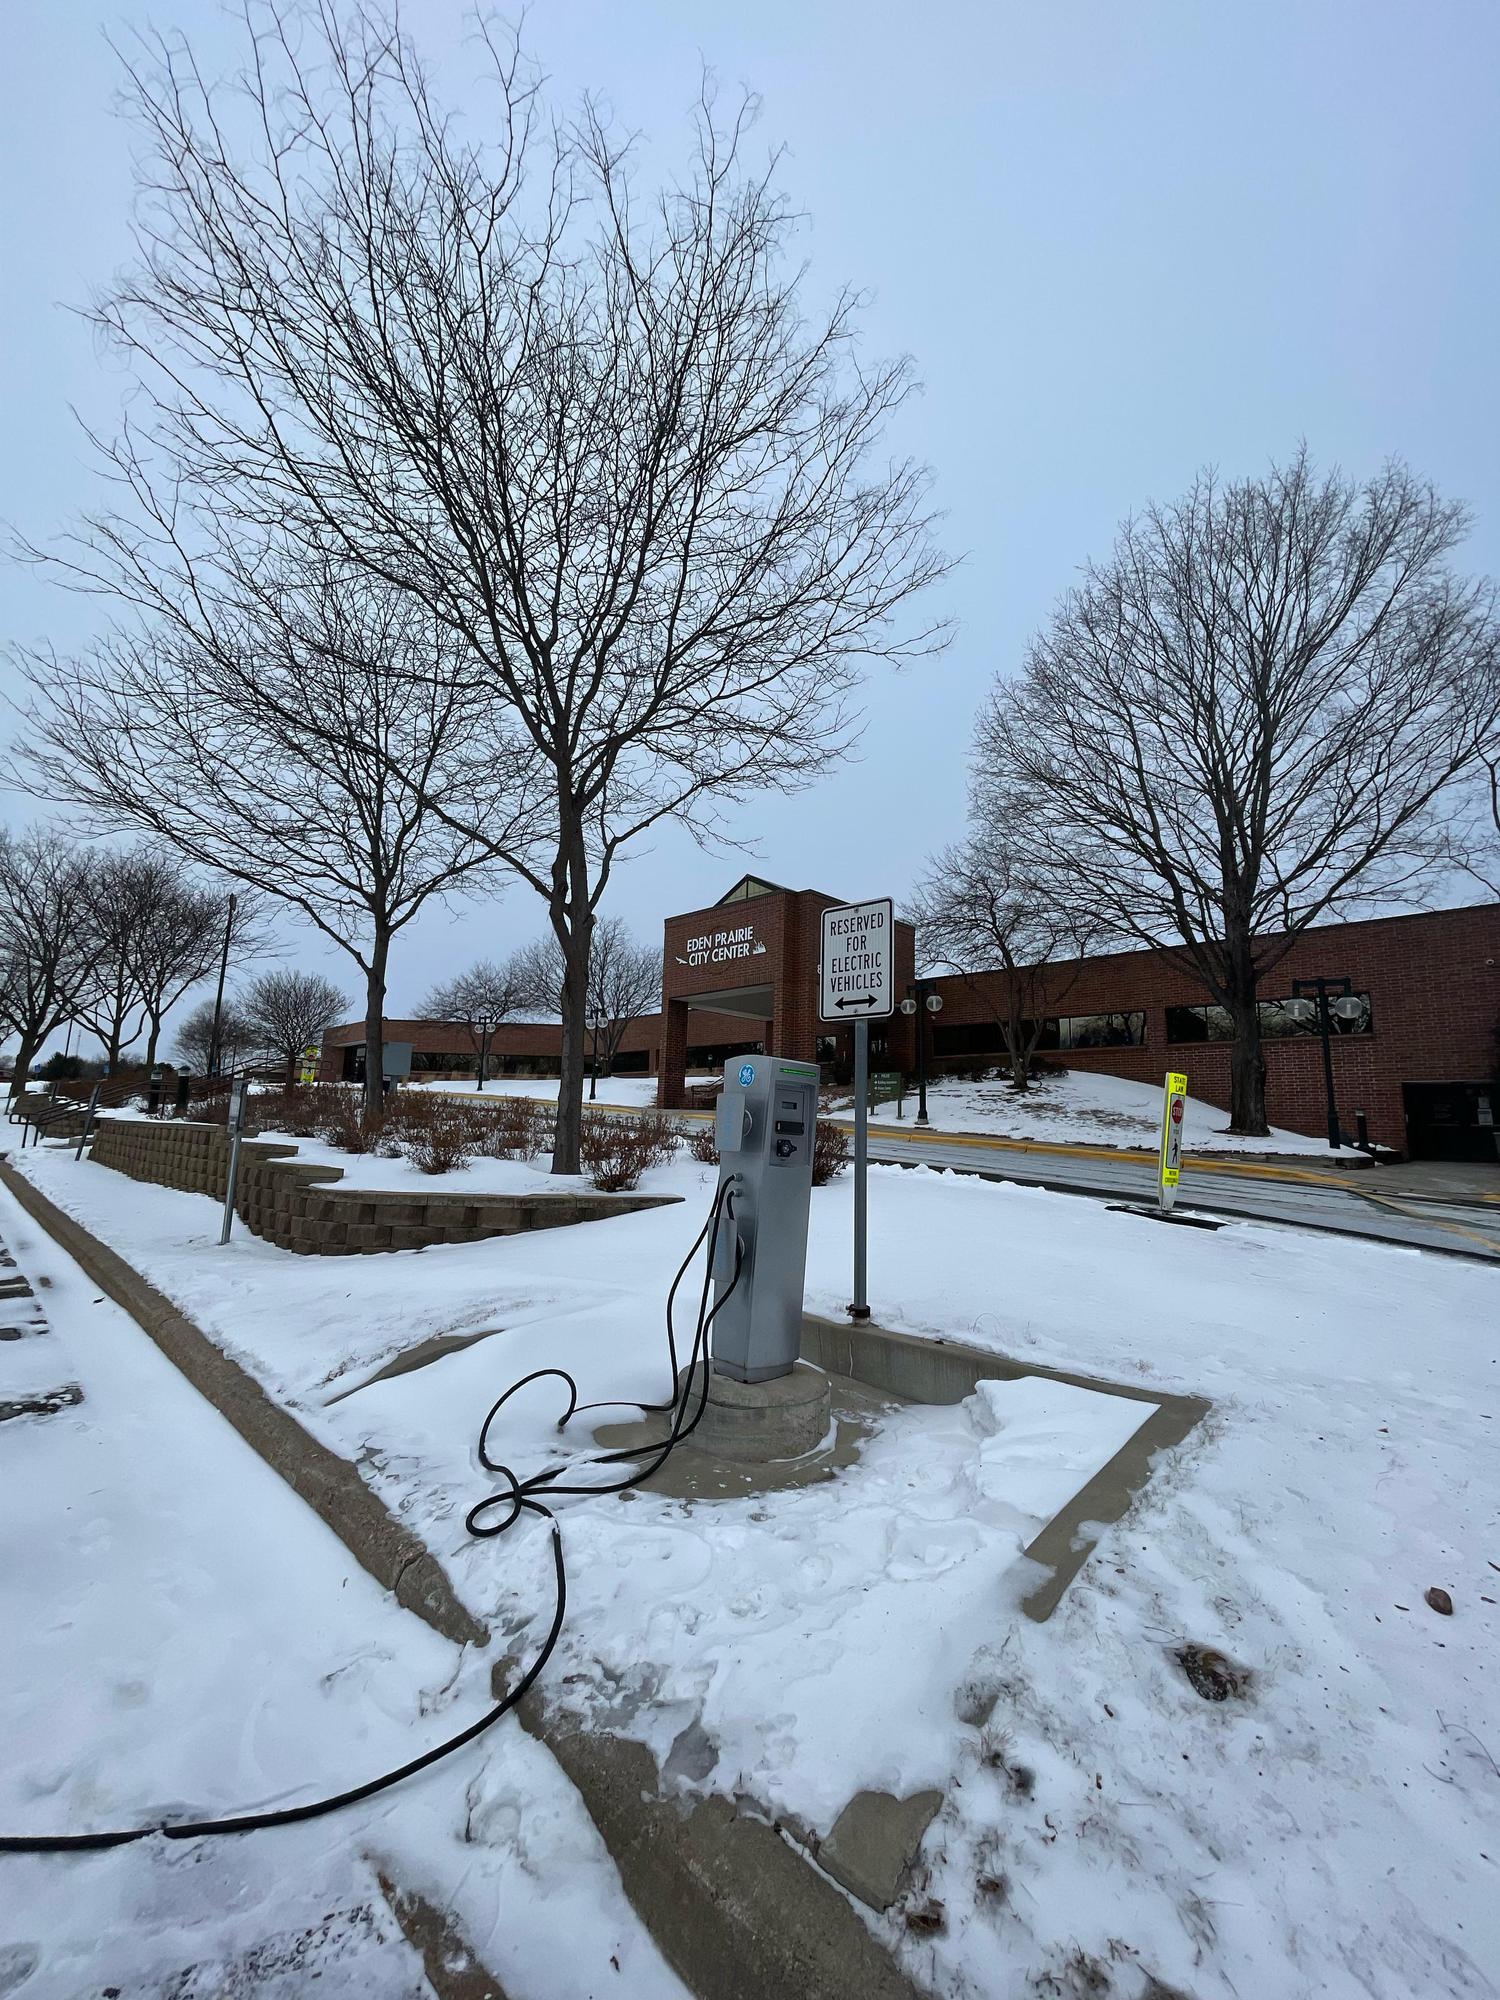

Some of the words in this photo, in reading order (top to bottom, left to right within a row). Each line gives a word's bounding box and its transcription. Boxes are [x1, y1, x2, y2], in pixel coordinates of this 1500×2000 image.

[830, 912, 884, 936] RESERVED
[686, 935, 712, 952] EDEN
[714, 926, 754, 947] PRAIRIE
[846, 935, 867, 953] FOR
[688, 950, 710, 966] CITY
[711, 943, 750, 962] CENTER
[831, 952, 882, 974] ELECTRIC
[830, 971, 883, 993] VEHICLES
[1174, 1076, 1186, 1085] STATE
[1173, 1106, 1183, 1116] STOP
